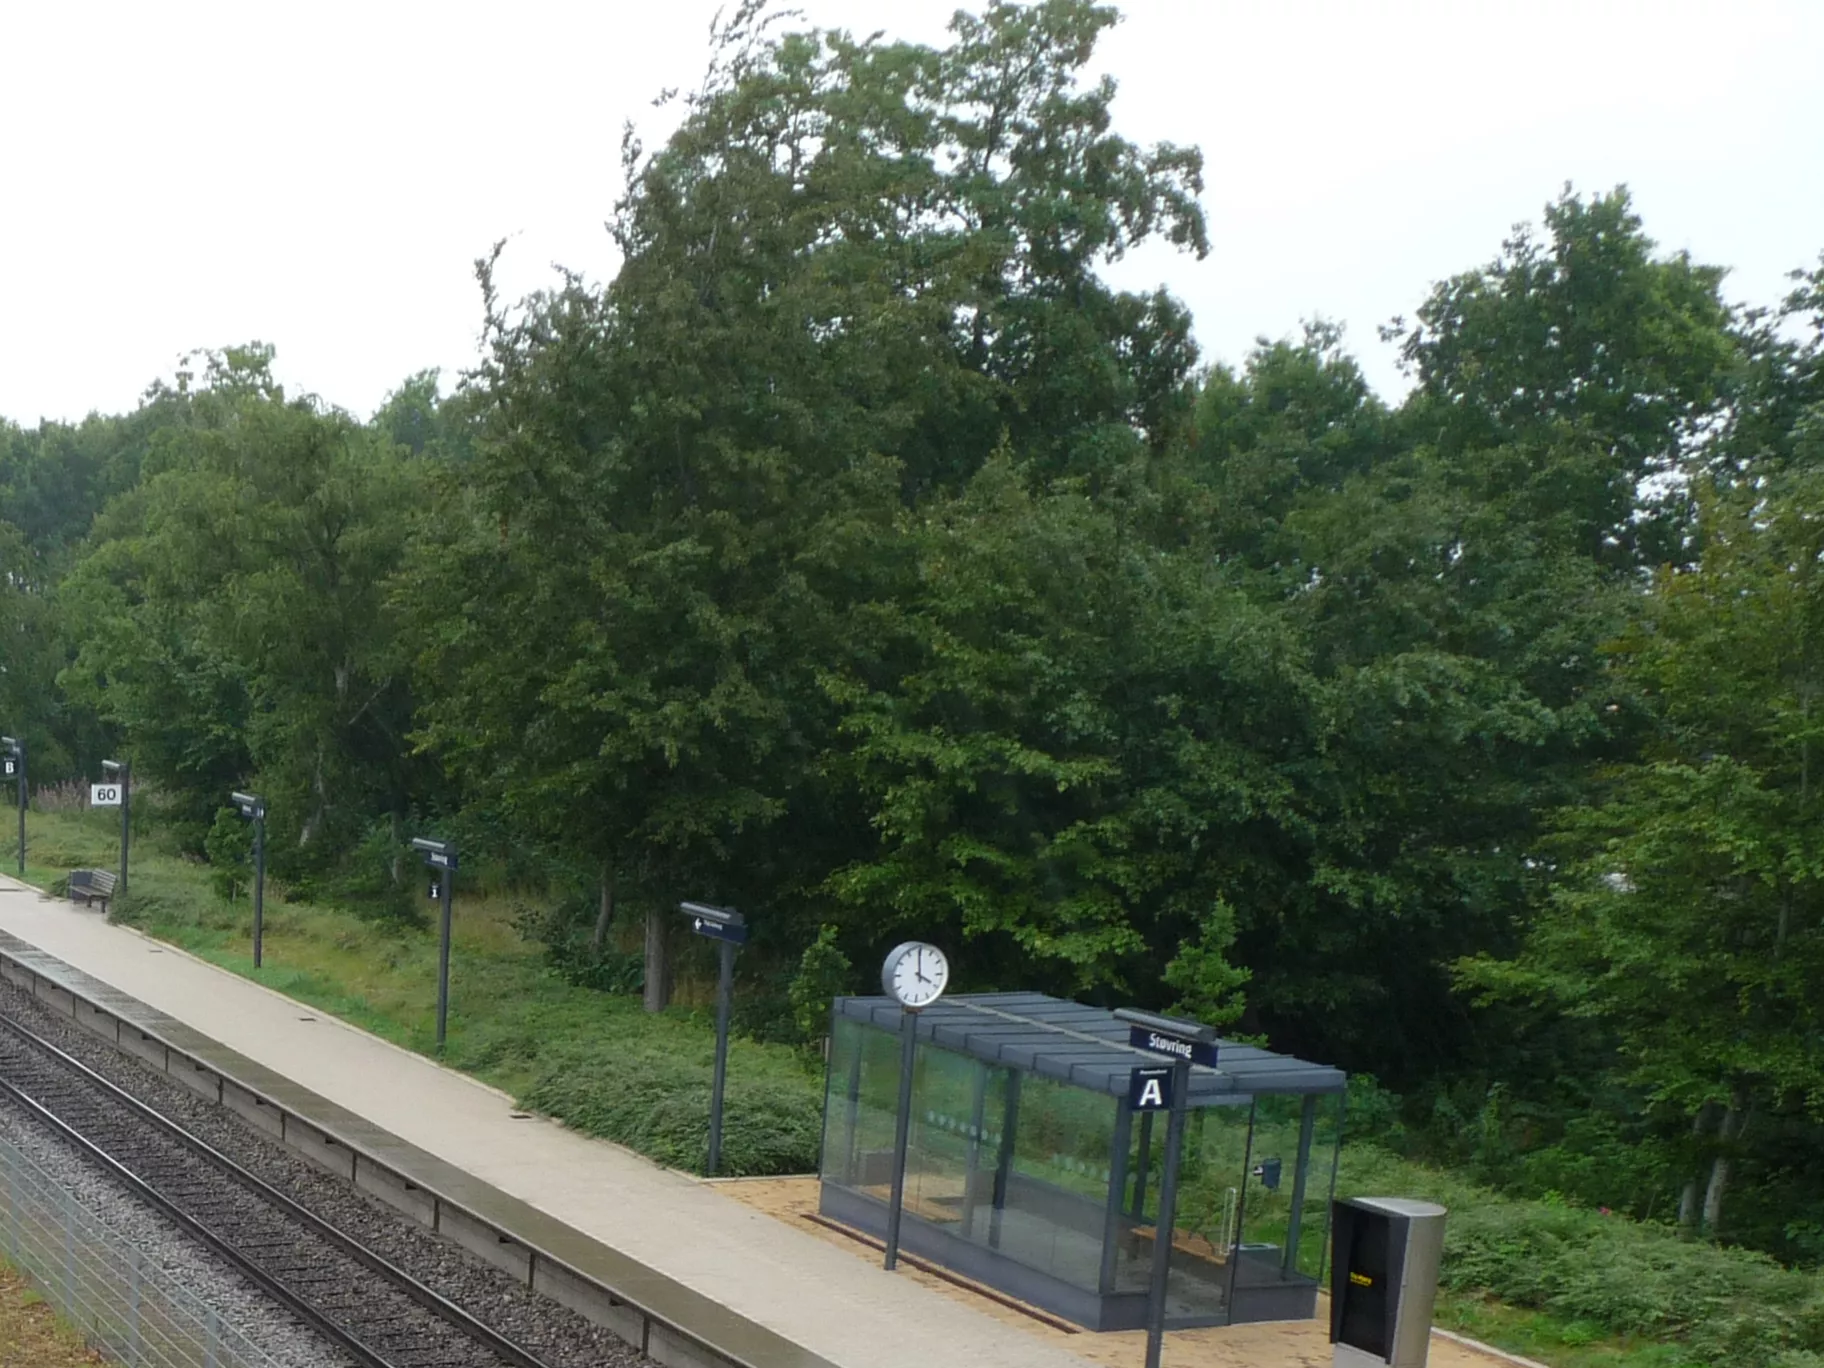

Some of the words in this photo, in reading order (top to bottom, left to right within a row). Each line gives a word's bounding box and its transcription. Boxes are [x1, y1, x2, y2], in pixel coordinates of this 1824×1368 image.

[5, 761, 14, 774] B
[97, 788, 116, 801] 60
[1149, 1033, 1192, 1059] Støvring
[1139, 1079, 1162, 1106] A
